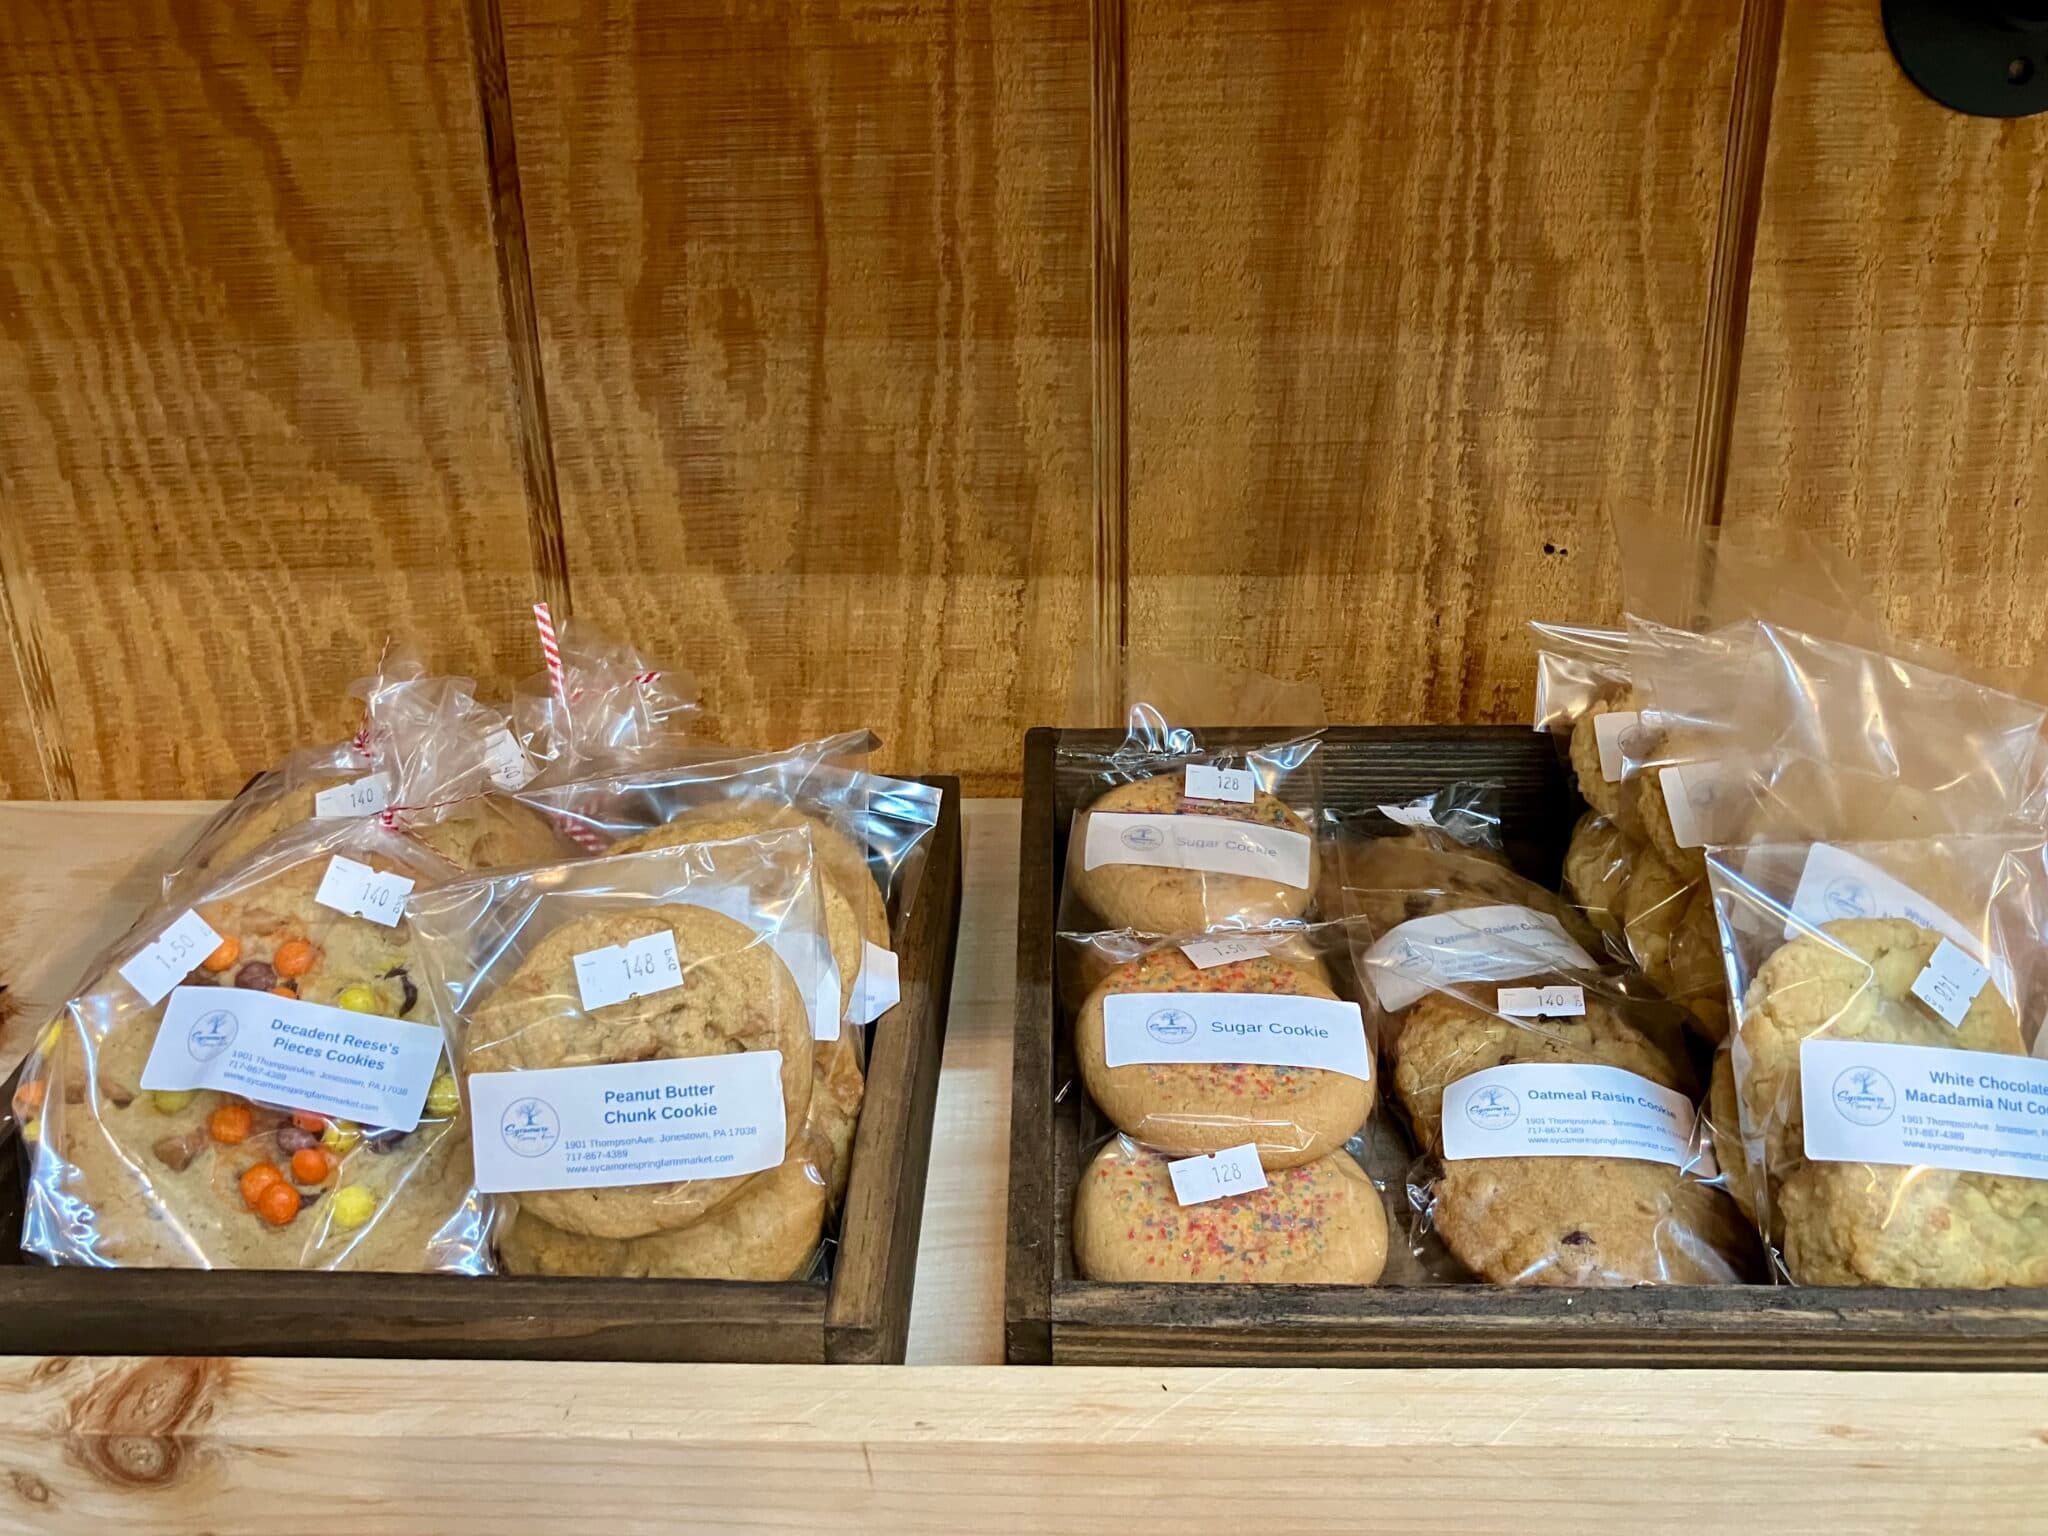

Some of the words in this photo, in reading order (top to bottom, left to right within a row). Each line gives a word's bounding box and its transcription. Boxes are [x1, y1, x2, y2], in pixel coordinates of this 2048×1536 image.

[1216, 775, 1240, 791] 128
[350, 787, 374, 808] 140
[1176, 837, 1220, 850] Sugar
[1225, 840, 1278, 857] Cookie
[362, 881, 390, 907] 140
[156, 933, 195, 969] 1.50
[1213, 943, 1248, 956] 1.50
[621, 951, 655, 981] 148
[1537, 994, 1565, 1007] 140
[270, 1018, 341, 1044] Decadent
[344, 1034, 401, 1056] Reese's
[1211, 1020, 1263, 1036] Sugar
[1268, 1022, 1330, 1039] Cookie
[273, 1036, 324, 1058] Pieces
[325, 1049, 386, 1071] Cookies
[231, 1049, 253, 1062] 1901
[367, 1080, 380, 1090] PA
[604, 1087, 661, 1104] Peanut
[665, 1083, 716, 1099] Butter
[1929, 1070, 1975, 1088] White
[1979, 1074, 2048, 1097] Chocolate
[604, 1107, 657, 1125] Chunk
[660, 1102, 718, 1120] Cookie
[1527, 1089, 1588, 1102] Oatmeal
[1591, 1090, 1635, 1105] Raisin
[1637, 1097, 1677, 1120] Cookie
[1904, 1088, 1994, 1110] Macadamia
[1997, 1098, 2023, 1113] Nut
[2026, 1101, 2048, 1116] Co
[565, 1140, 587, 1150] 1901
[713, 1128, 727, 1138] PA
[728, 1126, 758, 1137] 17038
[566, 1149, 629, 1162] 717-867-4389
[566, 1153, 734, 1174] www.sycamorespringfarmmarket.com
[1211, 1161, 1242, 1184] 128
